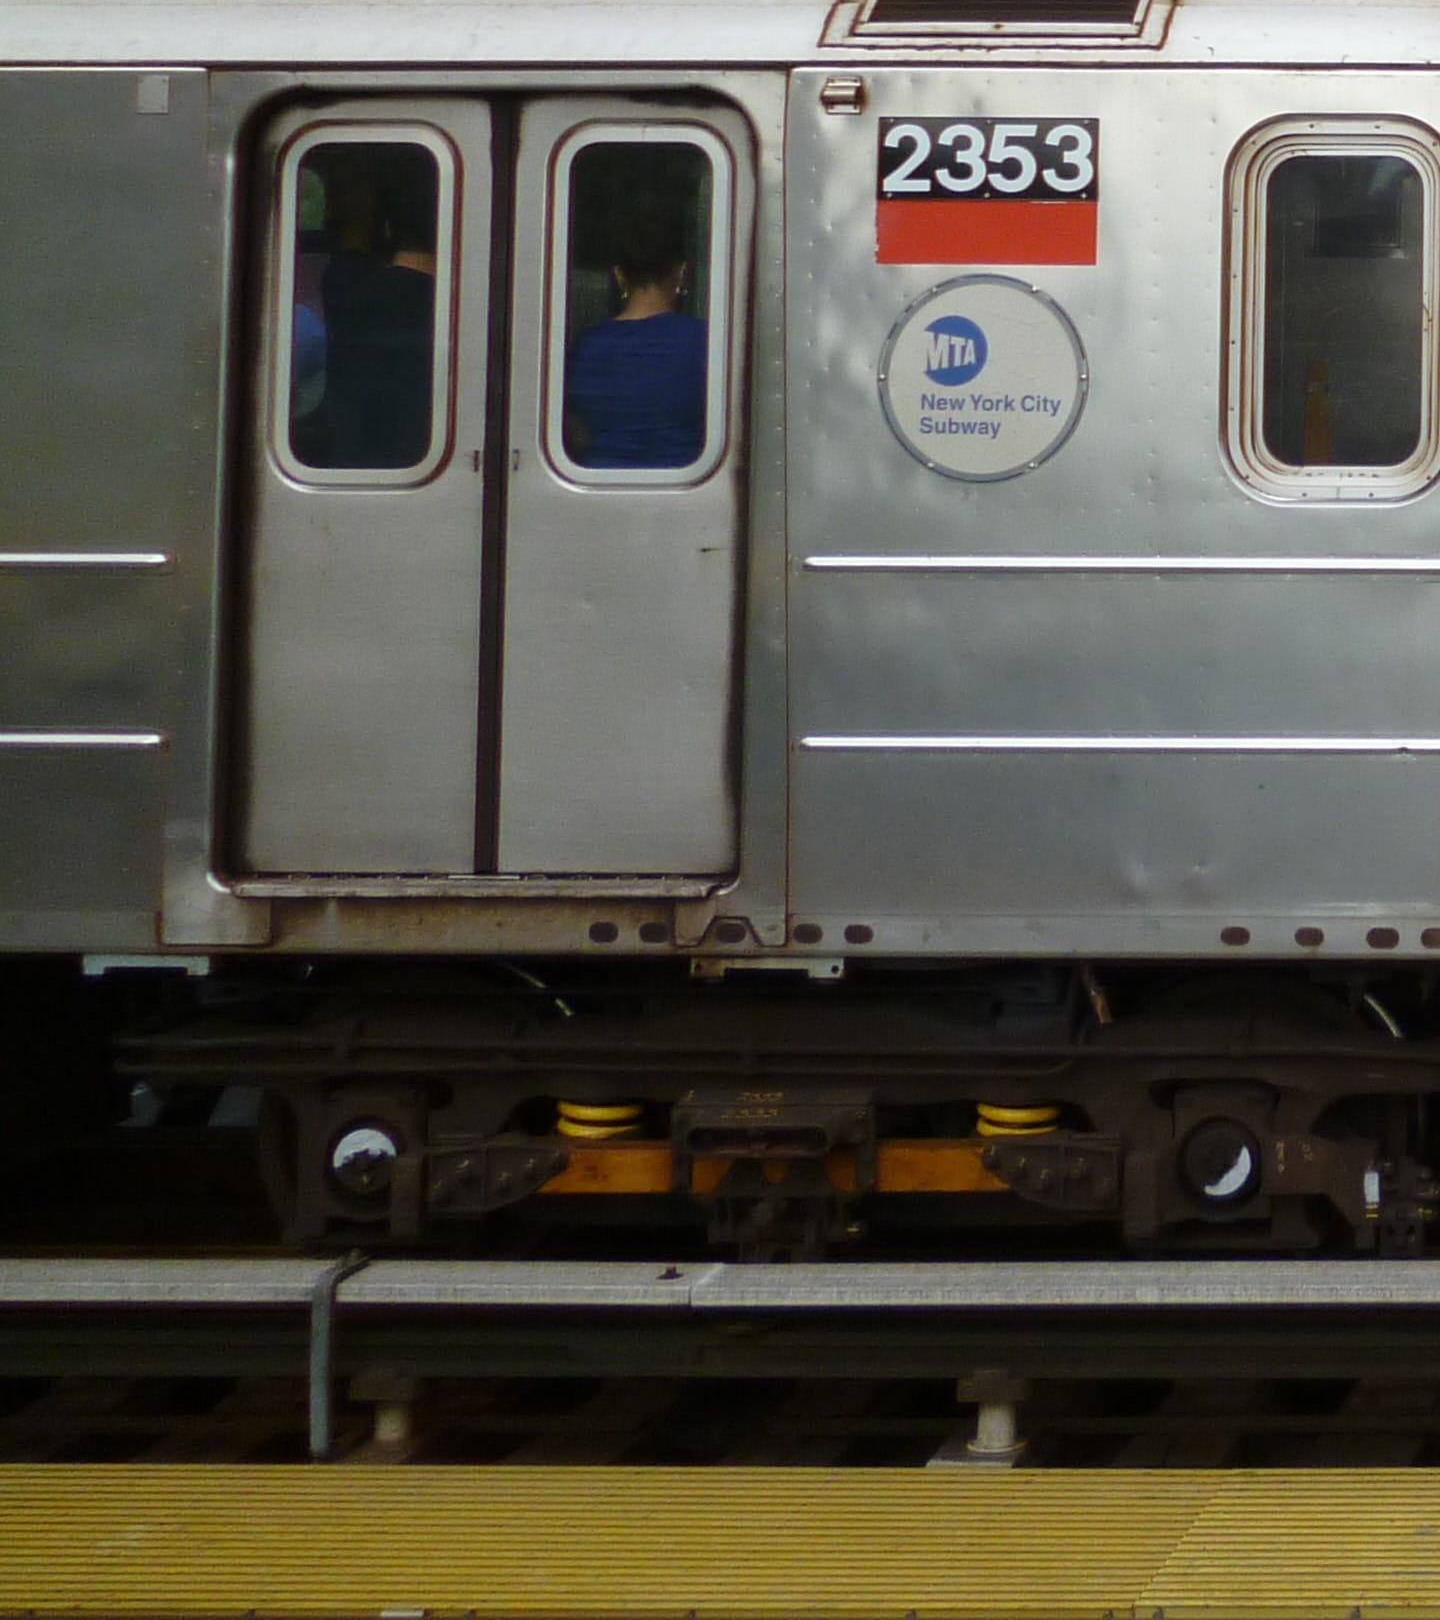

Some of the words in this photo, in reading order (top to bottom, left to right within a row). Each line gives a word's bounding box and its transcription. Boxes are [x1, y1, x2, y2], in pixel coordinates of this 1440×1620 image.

[882, 124, 1094, 193] 2353
[924, 330, 977, 372] MTA
[920, 393, 966, 411] New
[970, 393, 1016, 412] York
[1020, 395, 1062, 417] City
[919, 416, 1002, 440] Subway
